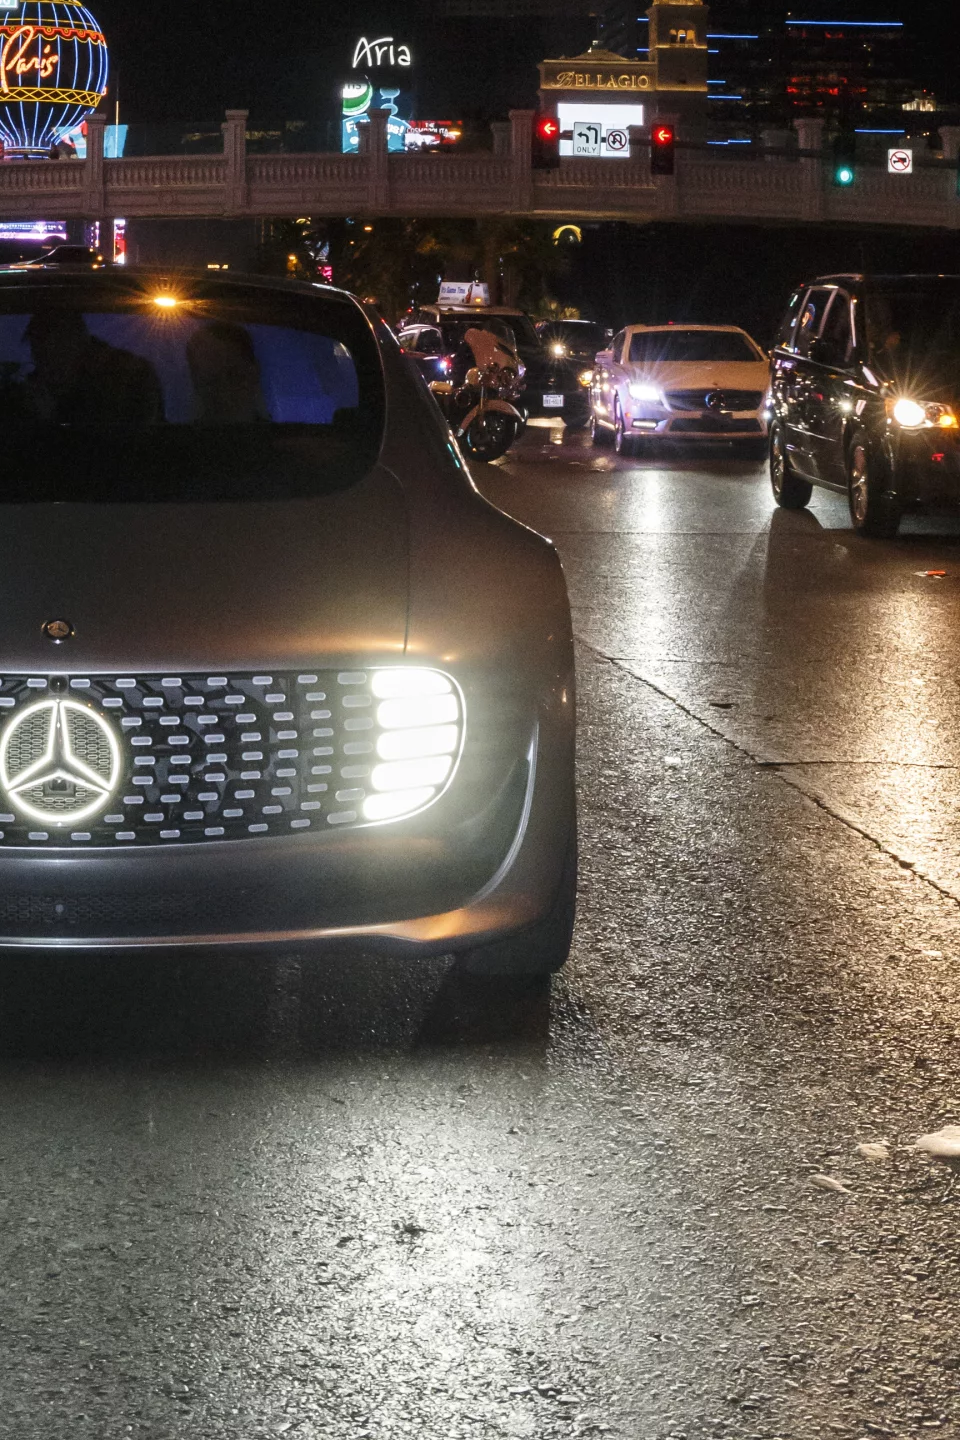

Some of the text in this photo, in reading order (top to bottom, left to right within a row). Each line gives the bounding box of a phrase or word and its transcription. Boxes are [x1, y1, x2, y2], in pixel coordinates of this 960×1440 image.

[0, 25, 59, 93] Paris
[352, 36, 411, 69] Aria
[551, 71, 649, 89] BELLAGIO
[576, 146, 597, 154] ONLY
